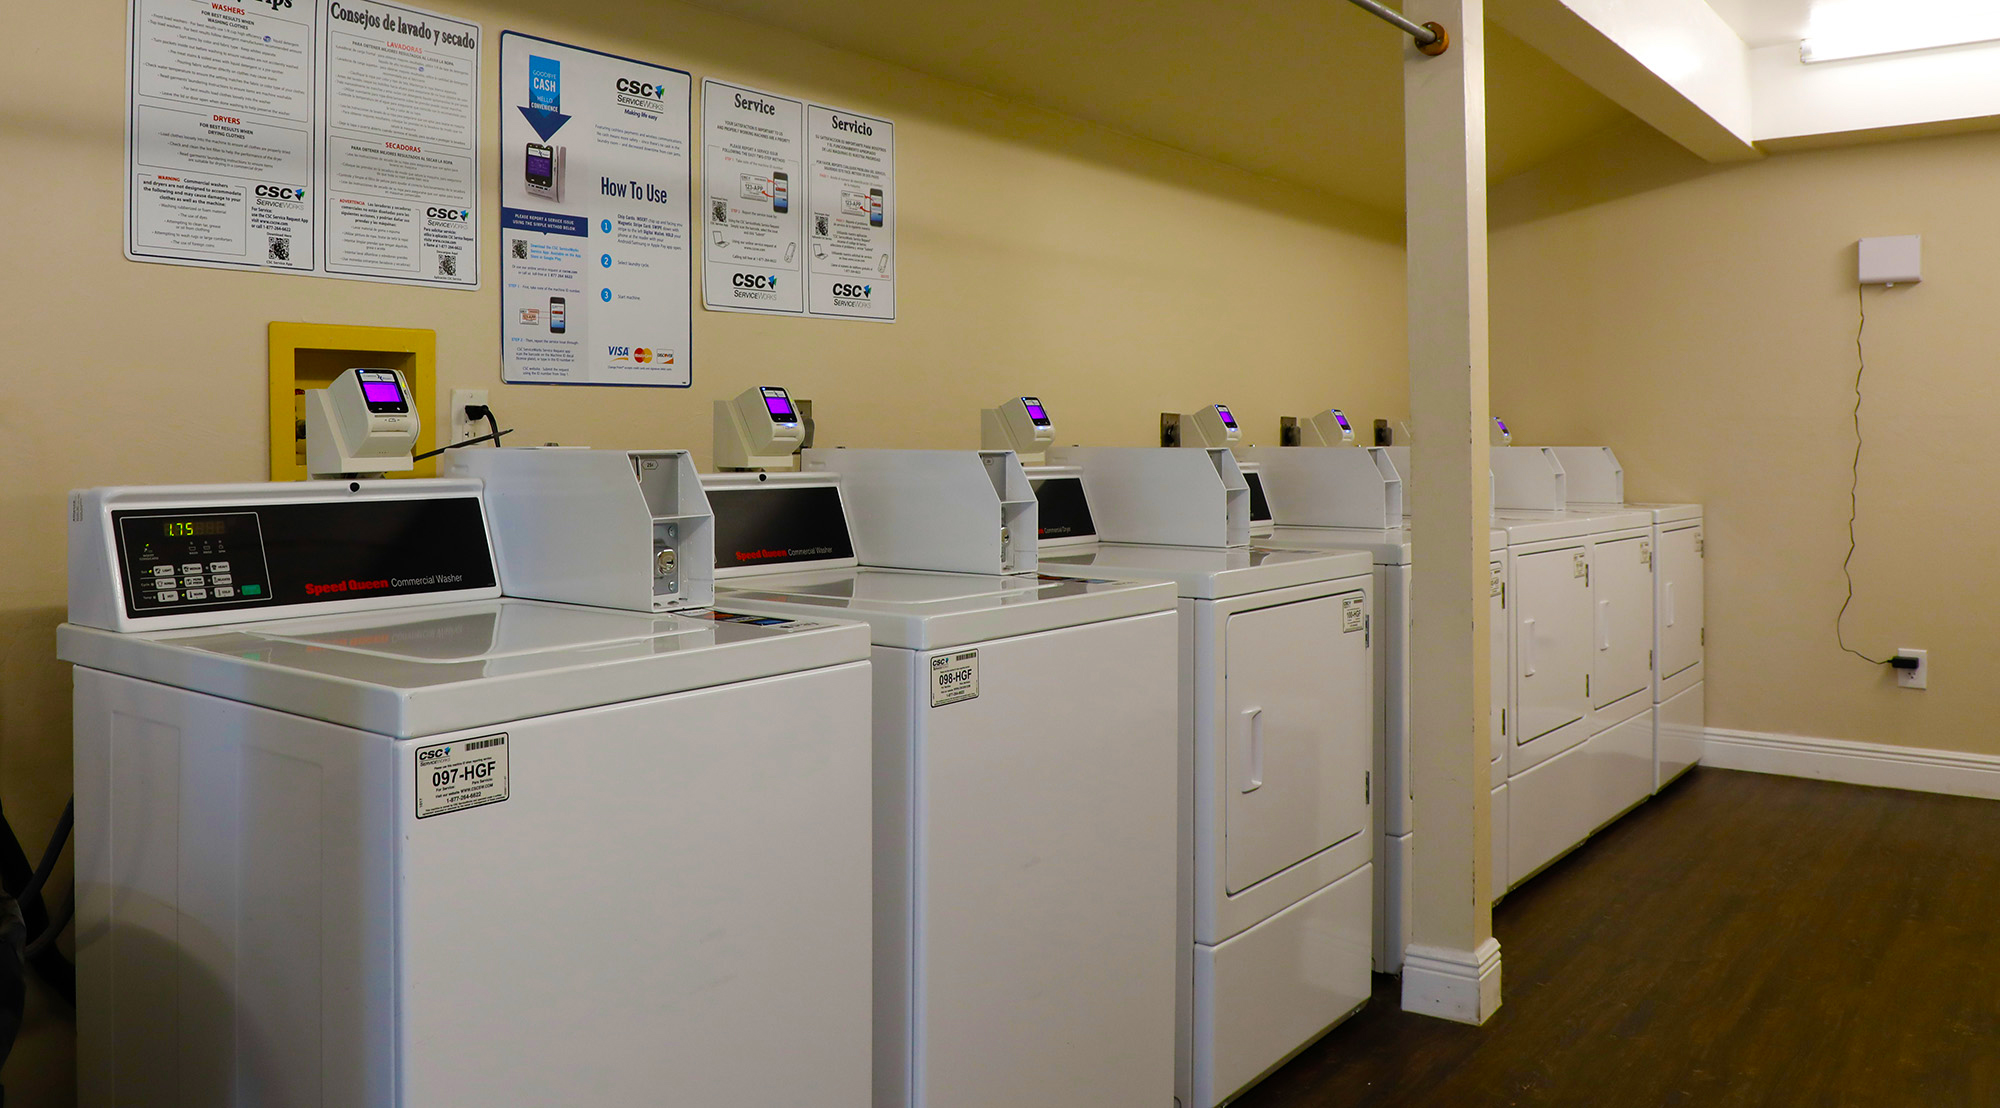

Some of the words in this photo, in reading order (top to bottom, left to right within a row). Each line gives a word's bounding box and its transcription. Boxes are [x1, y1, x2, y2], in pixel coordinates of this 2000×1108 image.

[212, 3, 245, 15] WASHERS
[208, 18, 228, 26] WASHING
[223, 15, 240, 23] RESULTS
[331, 2, 380, 30] Consejos
[382, 14, 395, 31] de
[398, 16, 431, 39] lavado
[434, 29, 440, 46] y
[442, 30, 474, 49] secado
[387, 41, 422, 54] LAVADORAS
[534, 77, 555, 92] CASH
[616, 78, 653, 97] CSC
[531, 102, 558, 112] CONVENIENCE
[734, 93, 775, 116] Service
[213, 115, 240, 124] DRYERS
[624, 109, 640, 118] Making
[832, 115, 872, 136] Servicio
[386, 142, 421, 153] SECADORAS
[255, 185, 292, 199] CSC
[601, 177, 626, 198] How
[630, 181, 643, 200] To
[647, 184, 667, 204] Use
[427, 207, 458, 220] CSC
[732, 273, 766, 289] CSC
[833, 283, 862, 298] CSC
[608, 346, 628, 356] VISA
[169, 522, 193, 536] 1.75
[736, 550, 761, 561] Speed
[762, 549, 787, 558] Queen
[305, 581, 347, 596] Speed
[349, 579, 388, 590] Queen
[391, 575, 435, 587] Commercial
[436, 574, 462, 584] Washer
[939, 669, 972, 685] 098-HGF
[419, 749, 443, 760] CSC
[432, 761, 496, 787] 097-HGF
[446, 792, 481, 803] 1-877-264-6622
